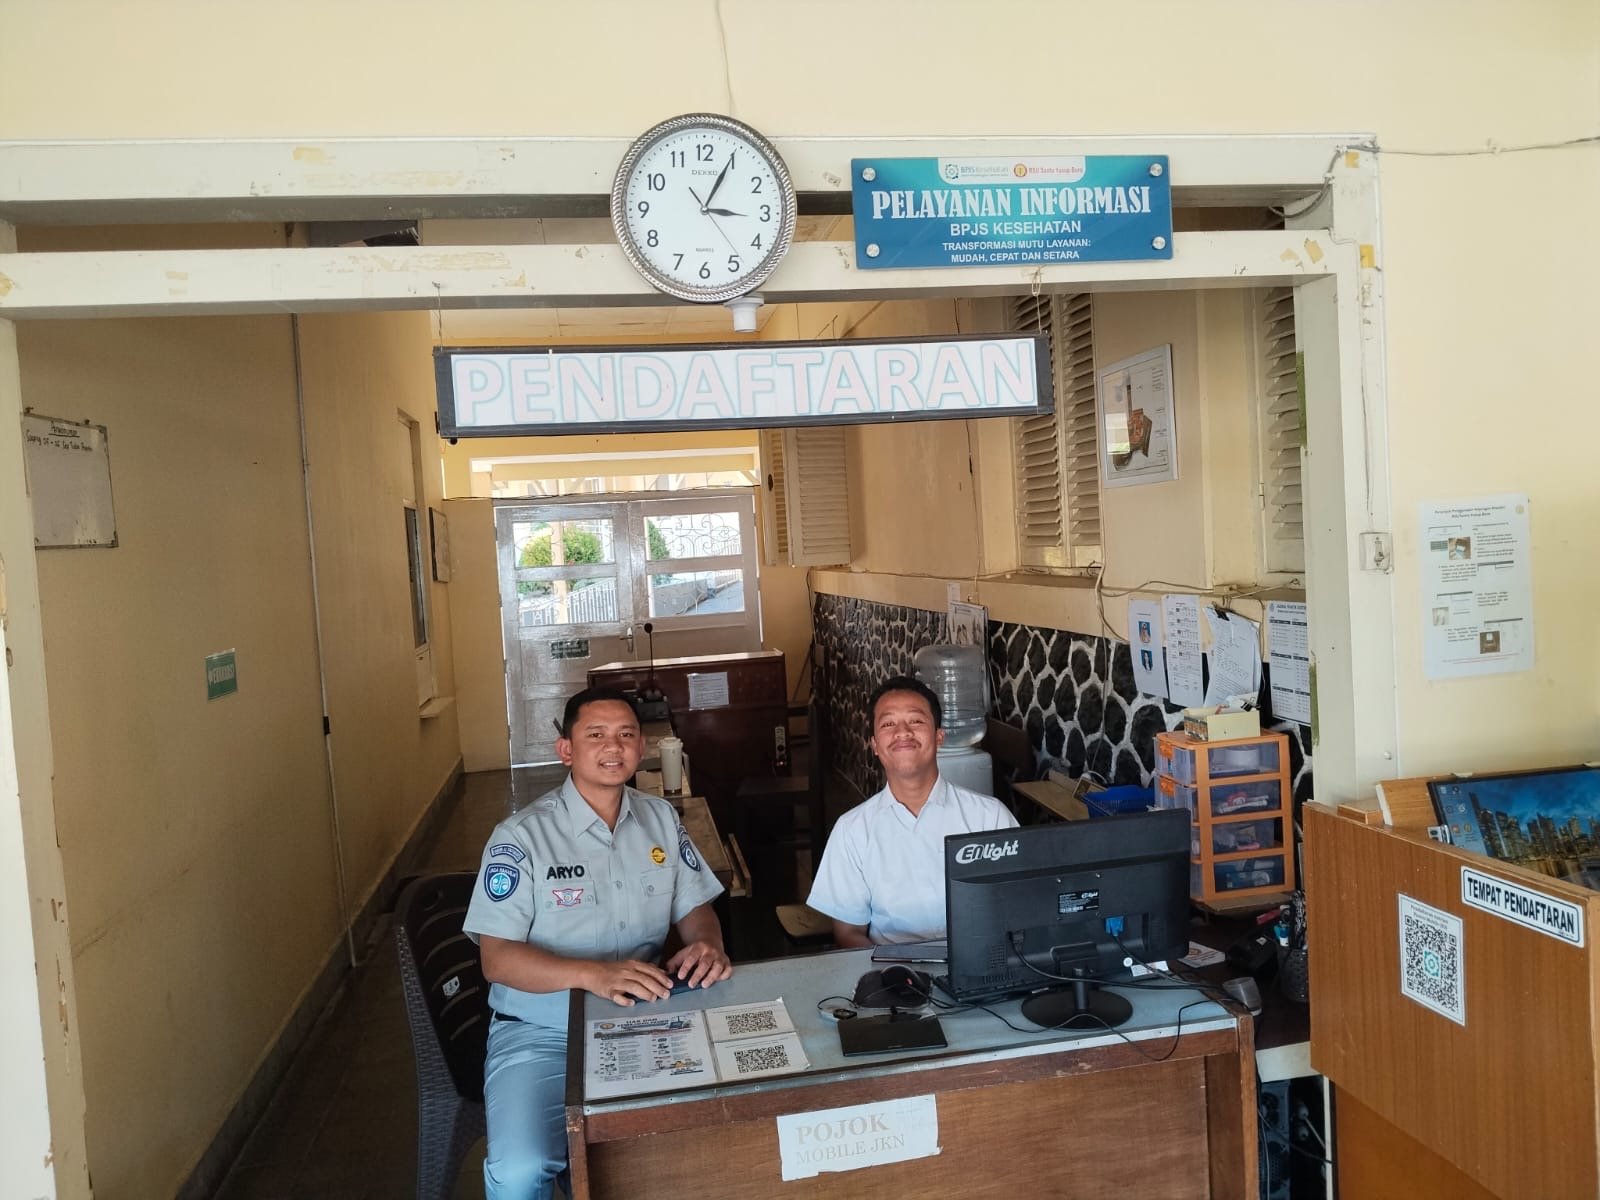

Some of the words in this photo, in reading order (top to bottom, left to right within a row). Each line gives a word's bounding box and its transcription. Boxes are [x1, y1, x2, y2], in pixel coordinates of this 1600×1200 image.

[670, 151, 685, 168] 11
[695, 144, 714, 162] 12
[647, 173, 666, 191] 10
[751, 177, 762, 194] 2
[637, 201, 650, 219] 9
[871, 188, 1012, 220] PELAYANAN
[1020, 186, 1152, 216] INFORMASI
[759, 204, 771, 222] 3
[950, 222, 989, 237] BPJS
[993, 220, 1082, 236] KESEHATAN
[646, 229, 659, 248] 8
[750, 233, 762, 250] 4
[942, 241, 1016, 252] TRANSFORMASI
[1018, 240, 1045, 250] MUTU
[1046, 239, 1091, 249] LAYANAN:
[673, 254, 684, 271] 7
[727, 255, 740, 273] 5
[951, 253, 987, 264] MUDAH,
[990, 252, 1020, 262] CEPAT
[1022, 251, 1041, 261] DAN
[1042, 250, 1080, 260] SETARA
[699, 261, 711, 279] 6
[454, 342, 1034, 423] PENDAFTARAN
[546, 865, 585, 880] ARYO
[1467, 877, 1502, 907] TEMPAT
[1504, 891, 1575, 935] PENDAFTARAN
[796, 1113, 890, 1145] POJOK
[796, 1141, 867, 1165] MOBILE
[870, 1134, 905, 1153] JKN
